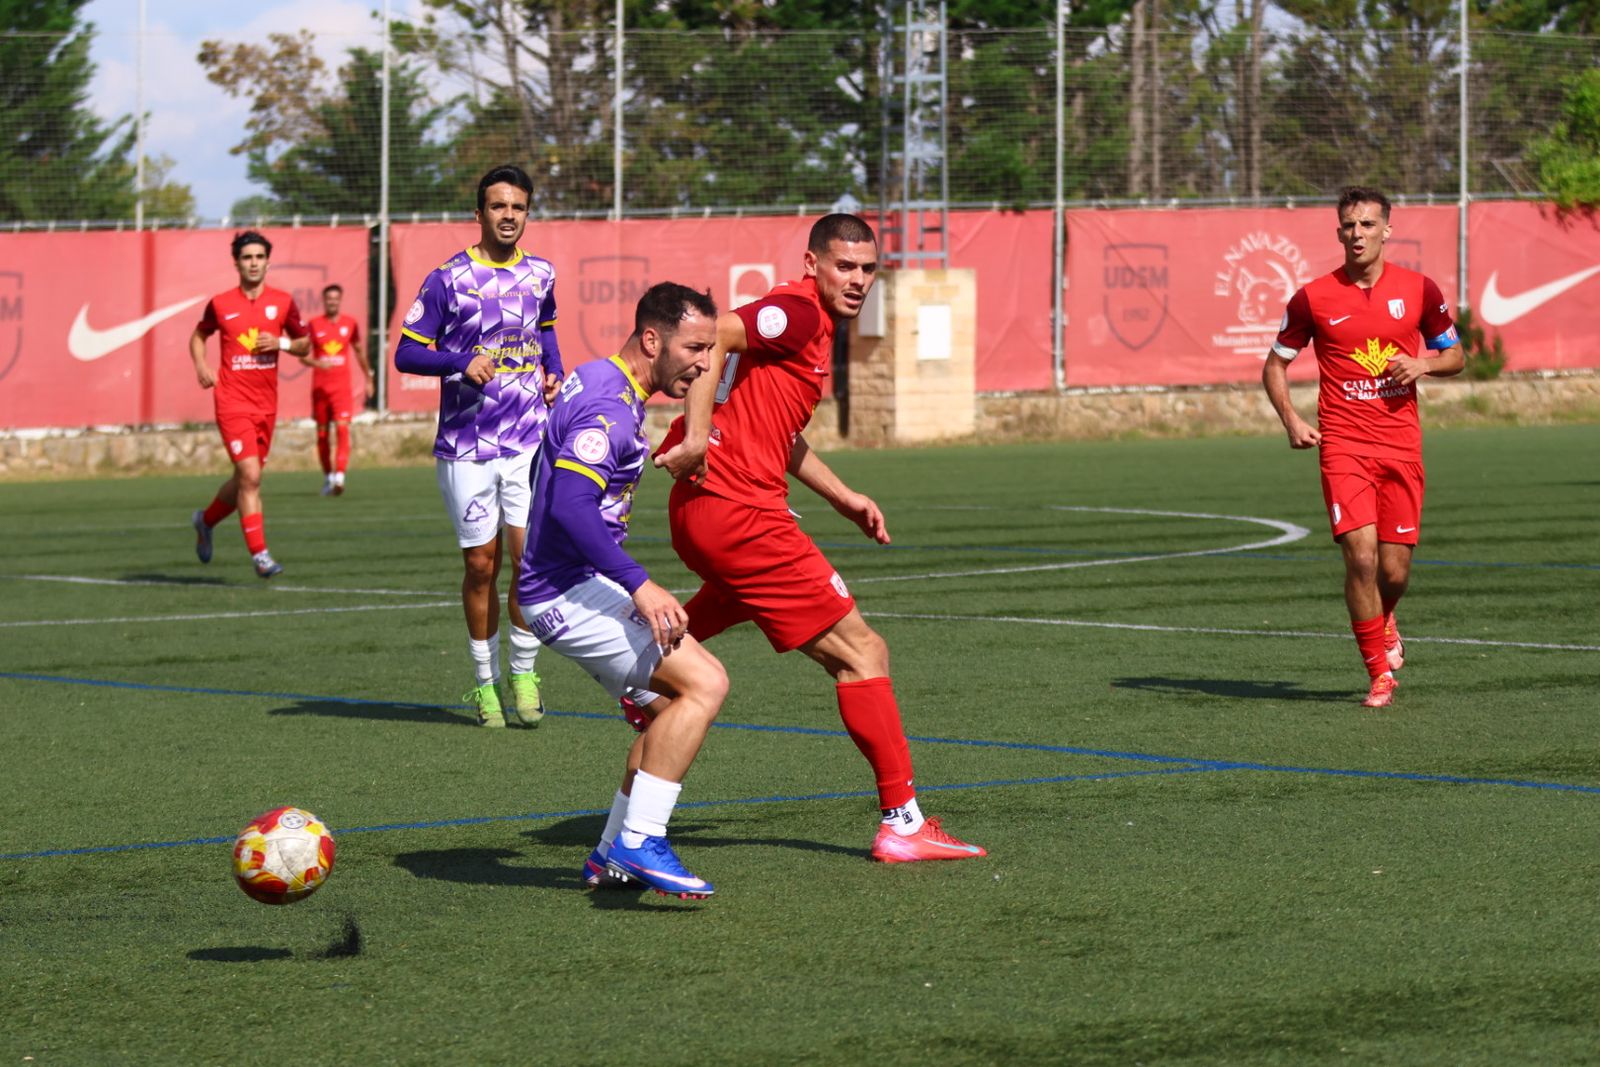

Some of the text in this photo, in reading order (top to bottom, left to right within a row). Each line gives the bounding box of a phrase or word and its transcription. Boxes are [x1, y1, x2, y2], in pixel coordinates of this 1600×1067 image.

[1104, 266, 1168, 289] UDSM
[1214, 269, 1234, 296] EL
[1342, 378, 1373, 393] CAJA
